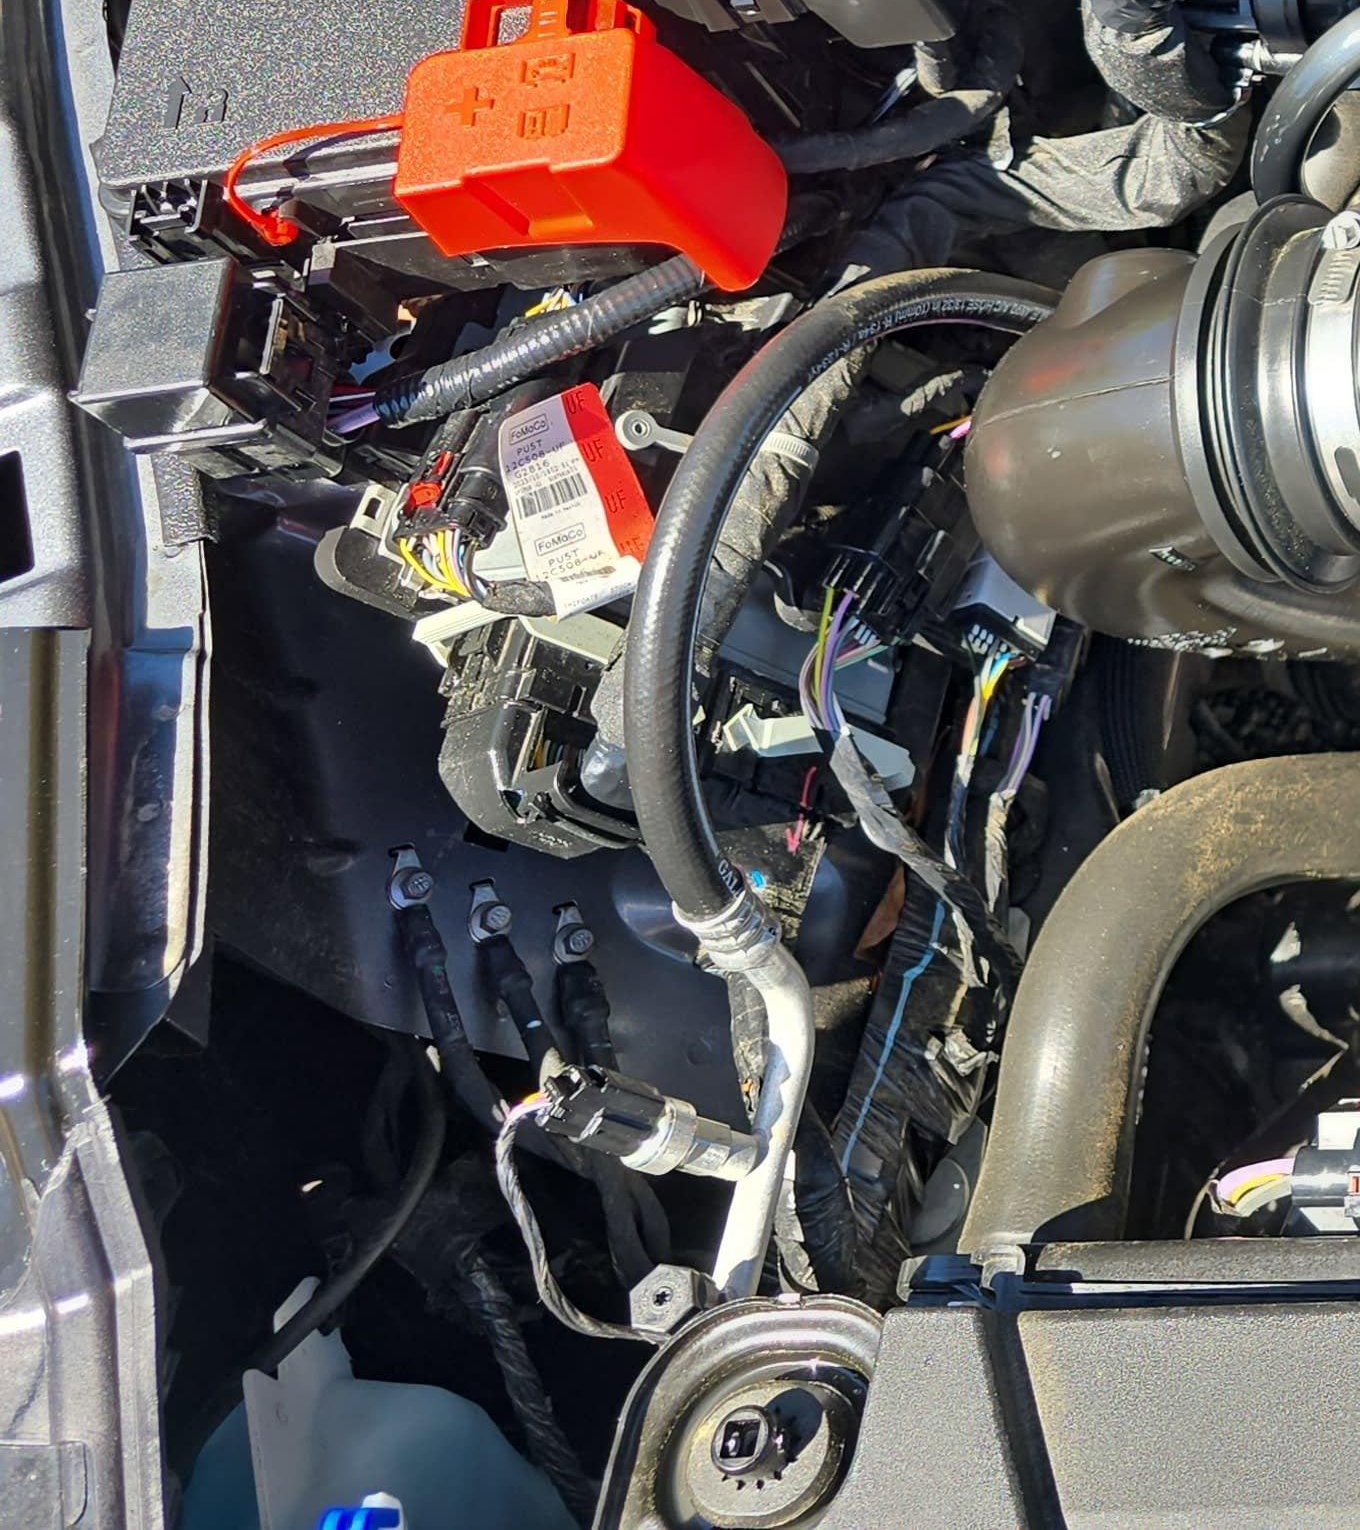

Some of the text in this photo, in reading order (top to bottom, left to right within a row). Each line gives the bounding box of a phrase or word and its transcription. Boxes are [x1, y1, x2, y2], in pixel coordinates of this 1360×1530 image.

[967, 298, 993, 313] HOSE
[564, 390, 585, 415] UF
[510, 418, 547, 440] FoMoCo
[581, 438, 604, 463] UF
[604, 489, 627, 515] UF
[537, 526, 585, 553] FoMoCo
